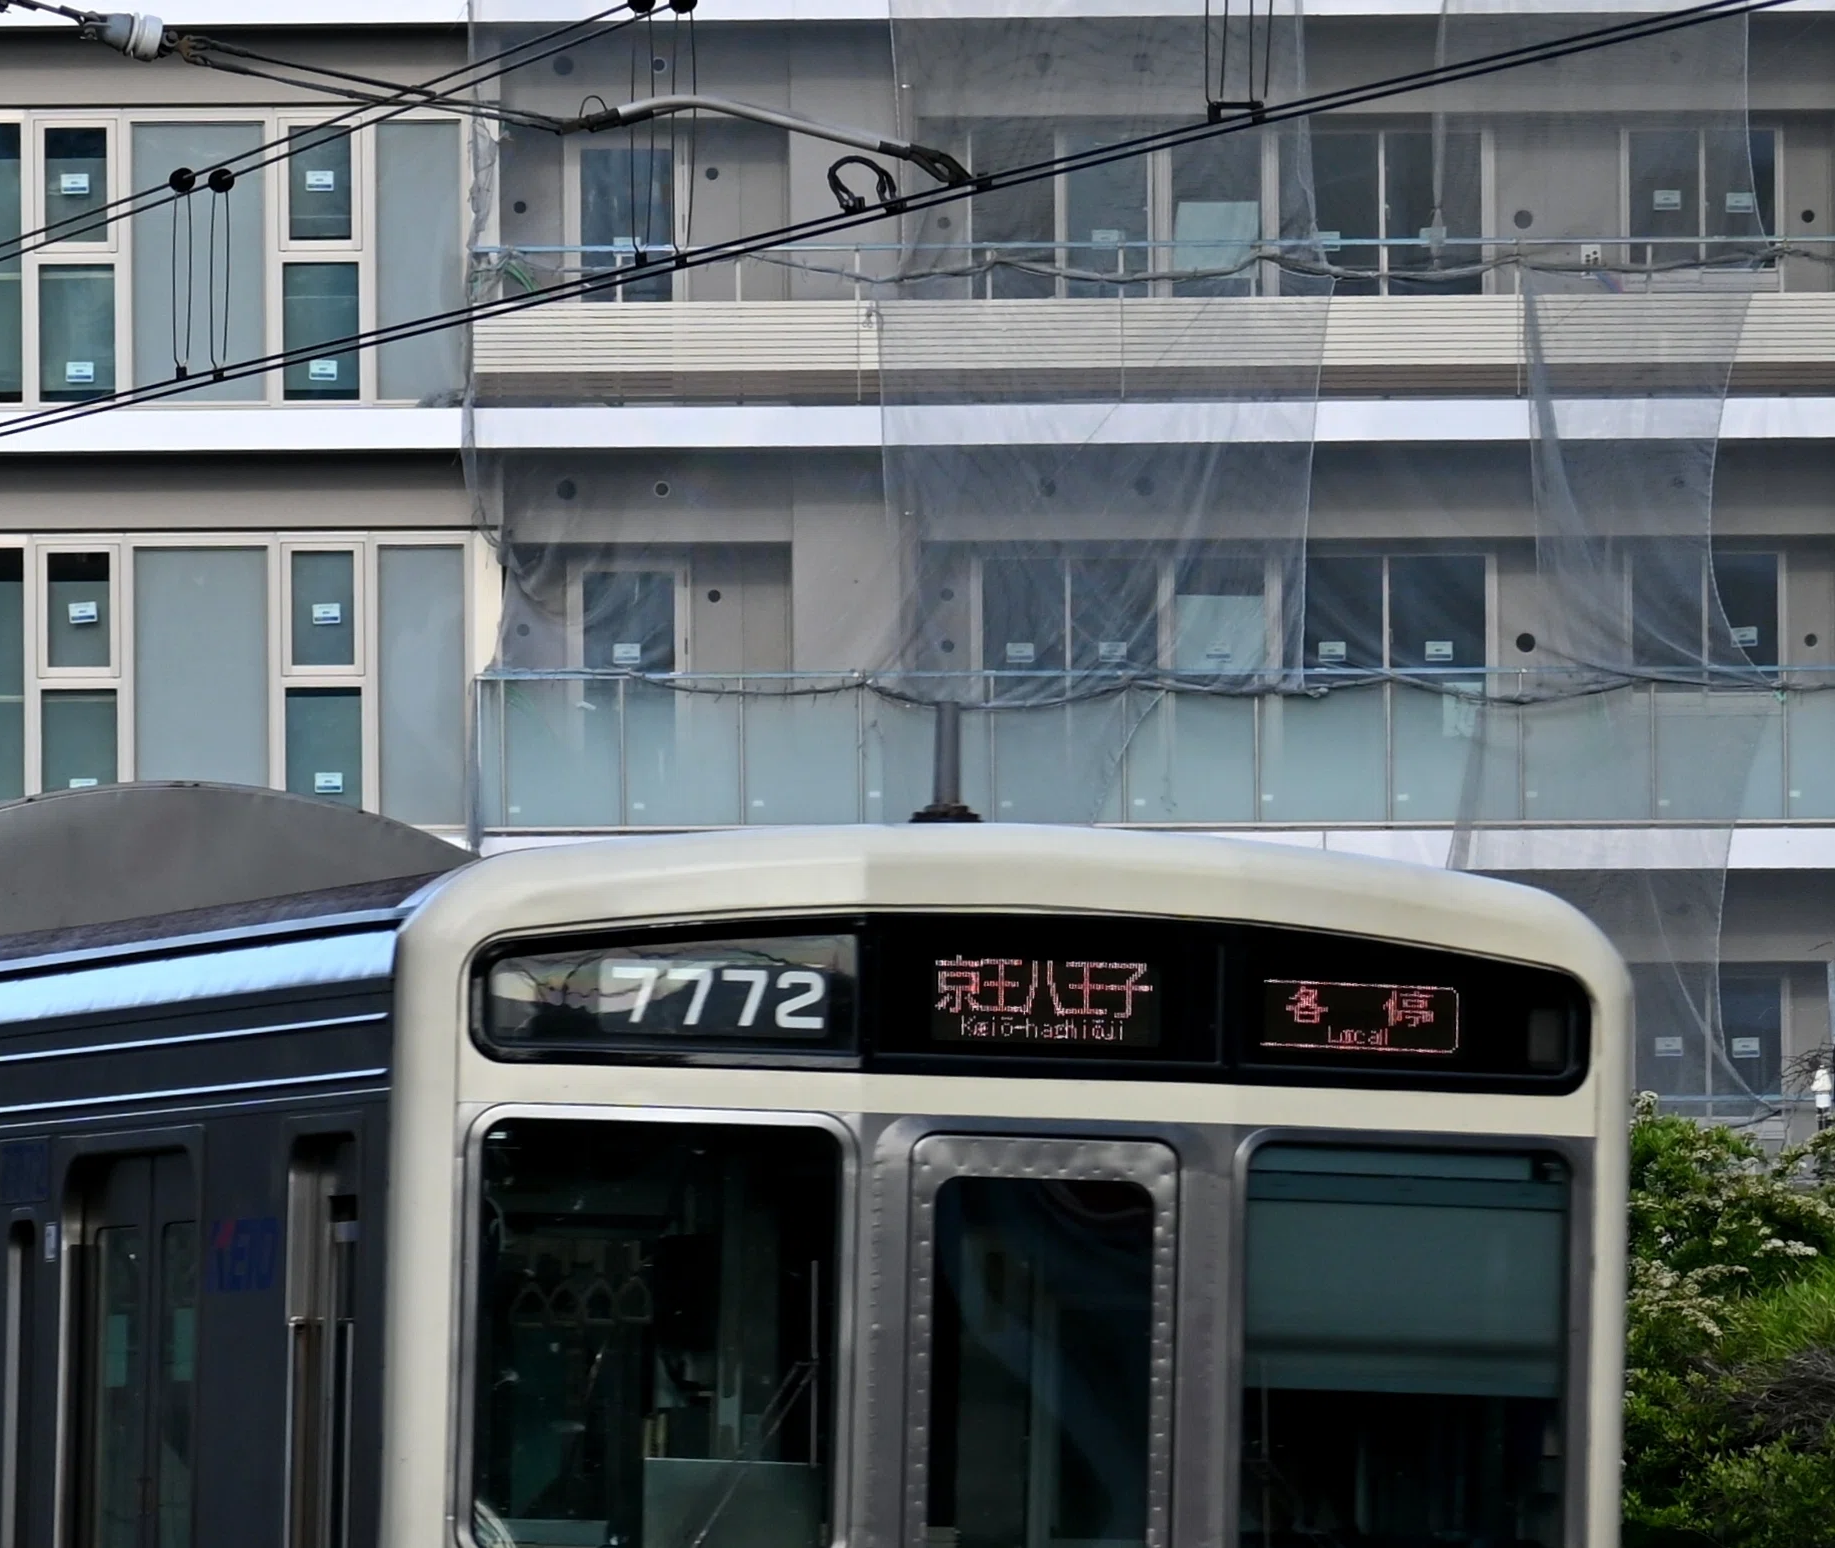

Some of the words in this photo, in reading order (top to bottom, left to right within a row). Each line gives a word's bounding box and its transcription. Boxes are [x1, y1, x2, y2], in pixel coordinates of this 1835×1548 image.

[612, 966, 825, 1030] 7772
[934, 954, 1154, 1019] 京王八王子
[1328, 1025, 1389, 1046] Local
[205, 1217, 278, 1293] KEIO
